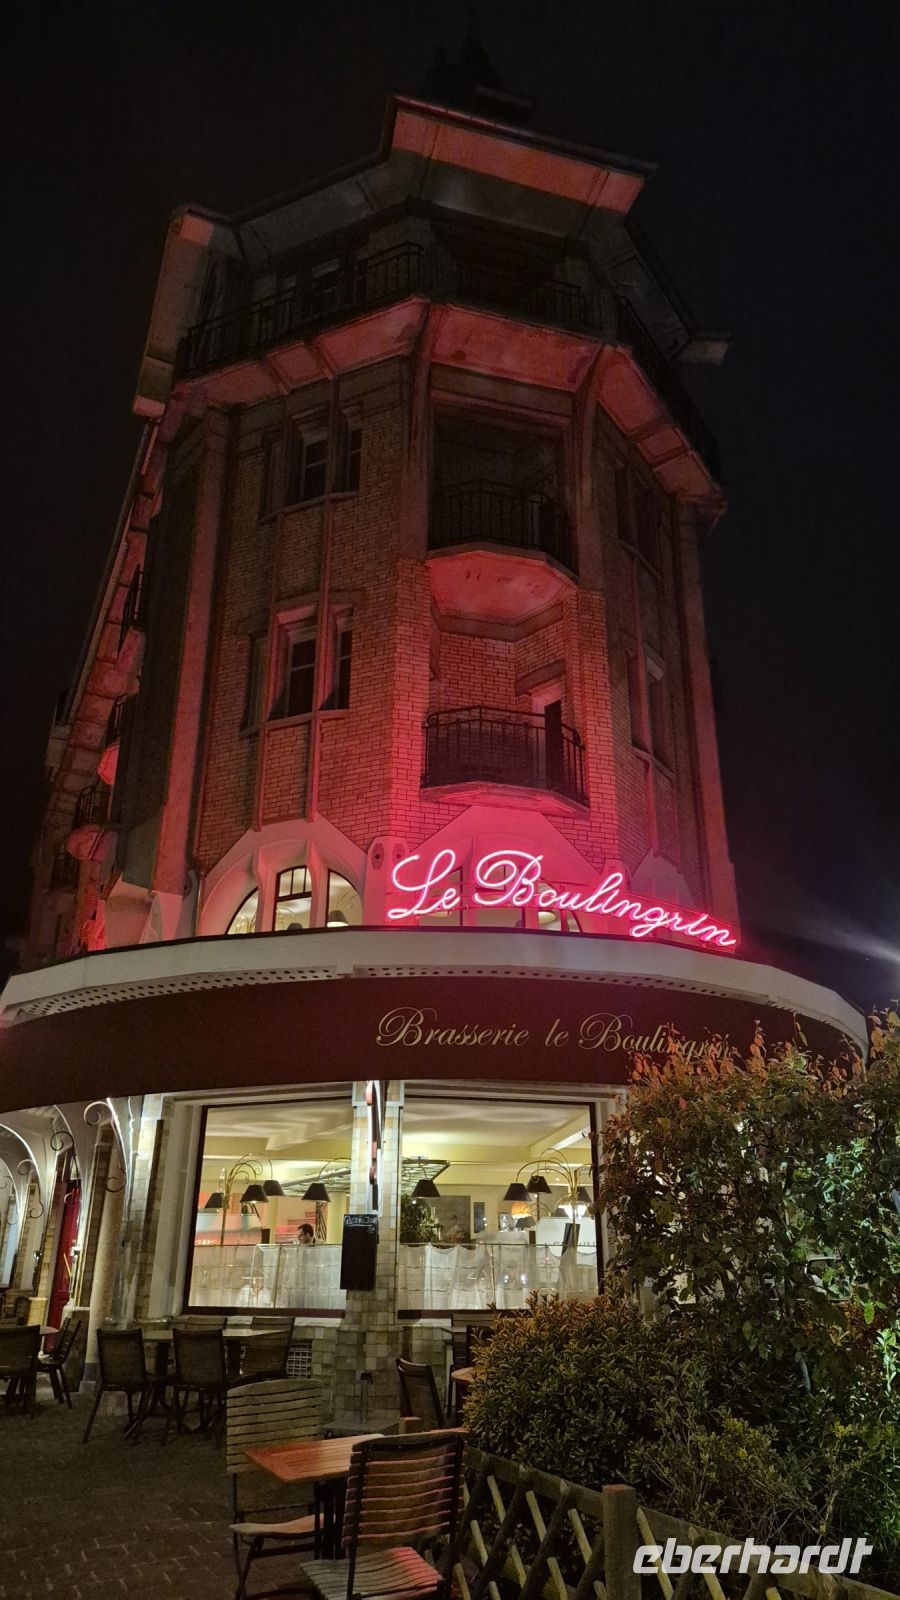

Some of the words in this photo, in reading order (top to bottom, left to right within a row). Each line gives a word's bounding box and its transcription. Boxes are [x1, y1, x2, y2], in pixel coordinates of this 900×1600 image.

[388, 849, 460, 919] Le
[473, 849, 736, 946] Boulingrin
[375, 1006, 530, 1047] Brasserie
[544, 1018, 569, 1047] le
